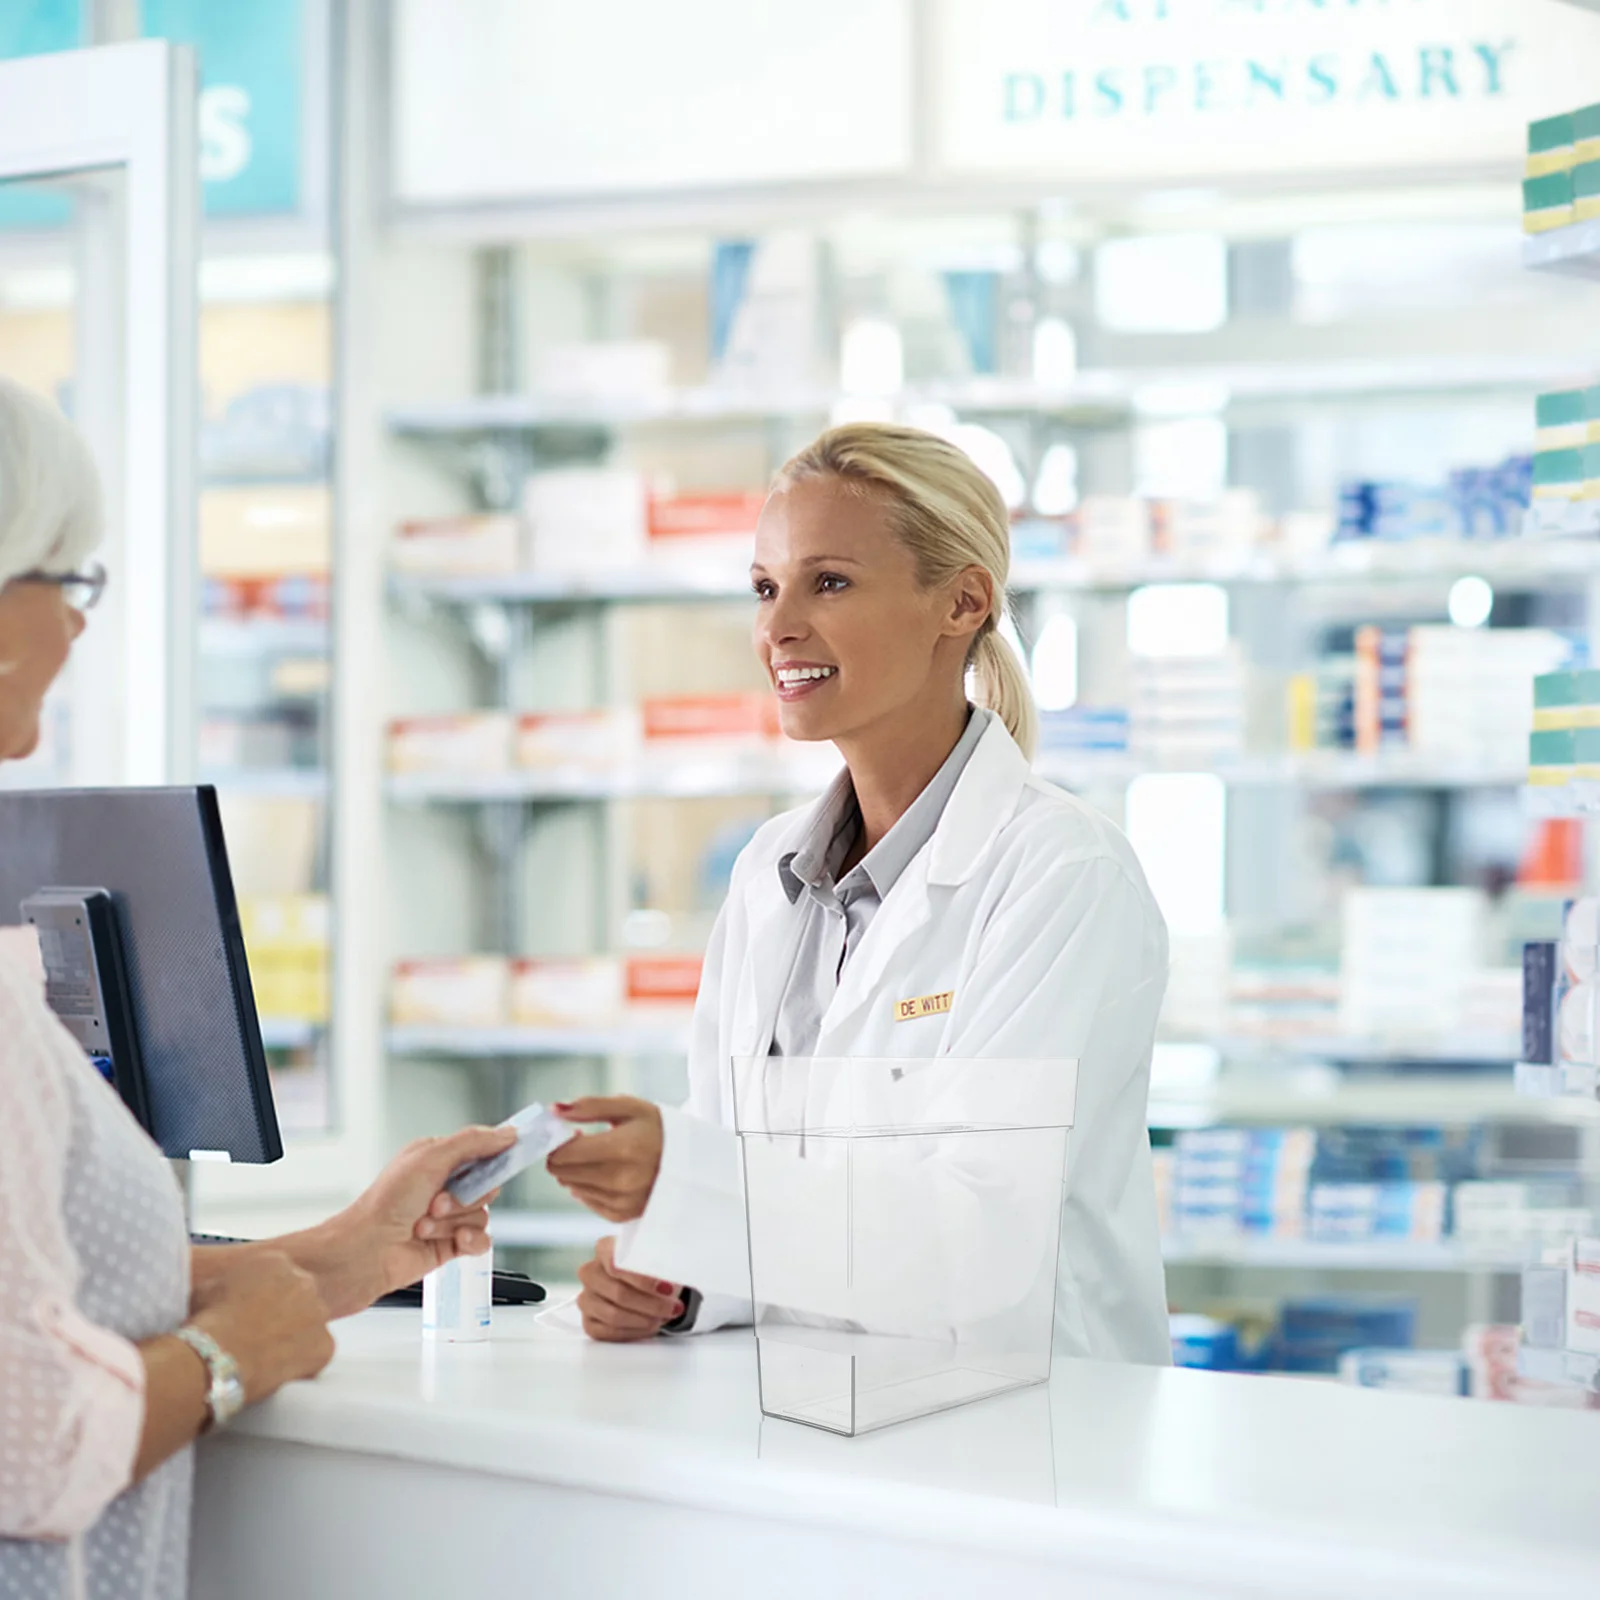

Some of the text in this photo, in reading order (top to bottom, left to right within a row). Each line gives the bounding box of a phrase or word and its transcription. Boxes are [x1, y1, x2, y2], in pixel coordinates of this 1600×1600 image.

[1002, 36, 1519, 123] DISPENSARY
[900, 993, 949, 1016] DE WITT
